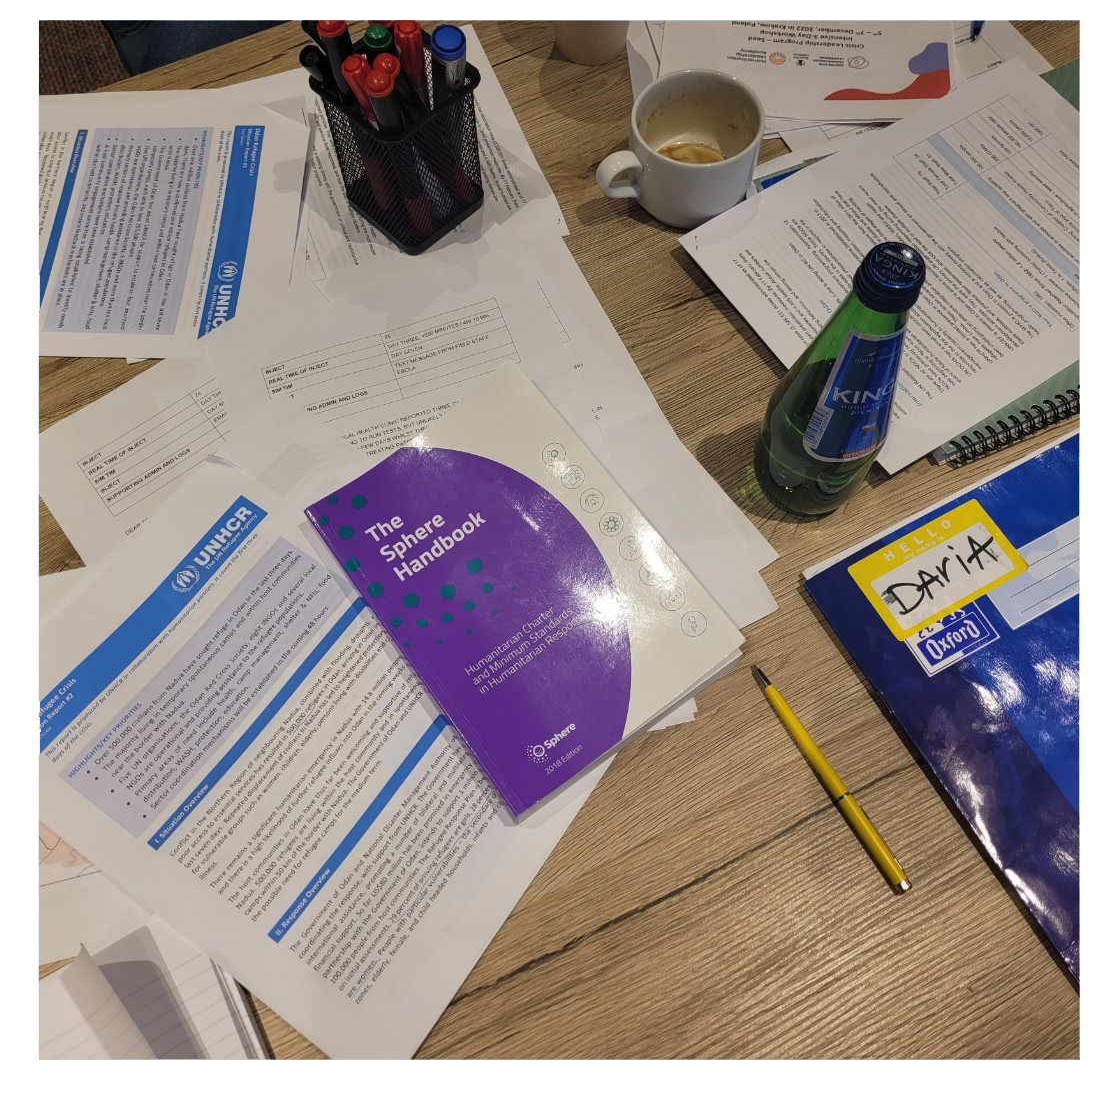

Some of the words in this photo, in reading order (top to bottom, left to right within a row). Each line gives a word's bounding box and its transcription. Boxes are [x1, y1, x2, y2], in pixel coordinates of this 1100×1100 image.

[759, 29, 796, 37] Workshop
[772, 36, 803, 45] Program
[797, 31, 818, 39] 3-Day
[804, 38, 843, 48] Leadership
[814, 25, 853, 34] December,
[819, 33, 852, 41] Intensive
[875, 255, 919, 279] KINGA
[80, 451, 103, 466] INJECT
[87, 463, 105, 476] REAL
[193, 503, 253, 568] UNHCR
[221, 530, 242, 553] Refugee
[239, 512, 259, 533] Agency
[364, 516, 404, 542] The
[380, 514, 445, 562] Sphere
[393, 512, 486, 581] Handbook
[883, 519, 951, 561] HELLO
[902, 553, 917, 561] my
[917, 542, 936, 556] name
[937, 535, 945, 543] is
[462, 630, 525, 676] Humanitarian
[520, 605, 557, 635] Charter
[470, 667, 491, 686] and
[487, 639, 533, 673] Minimum
[527, 606, 575, 643] Standards
[925, 620, 980, 660] Oxford
[57, 675, 77, 696] Crisis
[105, 677, 124, 697] UNHCR
[477, 682, 490, 695] in
[486, 641, 549, 689] Humanitarian
[46, 698, 68, 721] Report
[93, 748, 110, 766] Over
[107, 724, 133, 751] 500,000
[130, 703, 154, 728] civilians
[151, 689, 168, 706] from
[165, 671, 185, 692] Nadua
[211, 621, 230, 642] refuge
[67, 729, 114, 780] HIGHLIGHTS/KEY
[111, 700, 142, 733] PRIORITIES
[102, 757, 116, 772] The
[113, 732, 140, 760] majority
[136, 716, 155, 736] living
[159, 680, 189, 713] temporary
[151, 725, 186, 763] operational
[542, 721, 579, 750] Sphere
[110, 761, 126, 778] near
[123, 750, 136, 764] the
[133, 730, 155, 753] border
[152, 717, 167, 733] with
[134, 771, 159, 798] Primary
[157, 753, 175, 772] areas
[196, 705, 218, 729] include
[150, 787, 171, 810] Sector
[167, 750, 204, 790] coordination
[201, 715, 236, 753] mechanisms
[543, 758, 563, 775] 2018
[559, 743, 584, 763] Edition
[117, 769, 132, 784] Five
[141, 764, 178, 804] distribution,
[158, 808, 186, 840] Situation
[182, 781, 210, 813] Overview
[280, 896, 308, 929] Response
[304, 866, 331, 898] Overview
